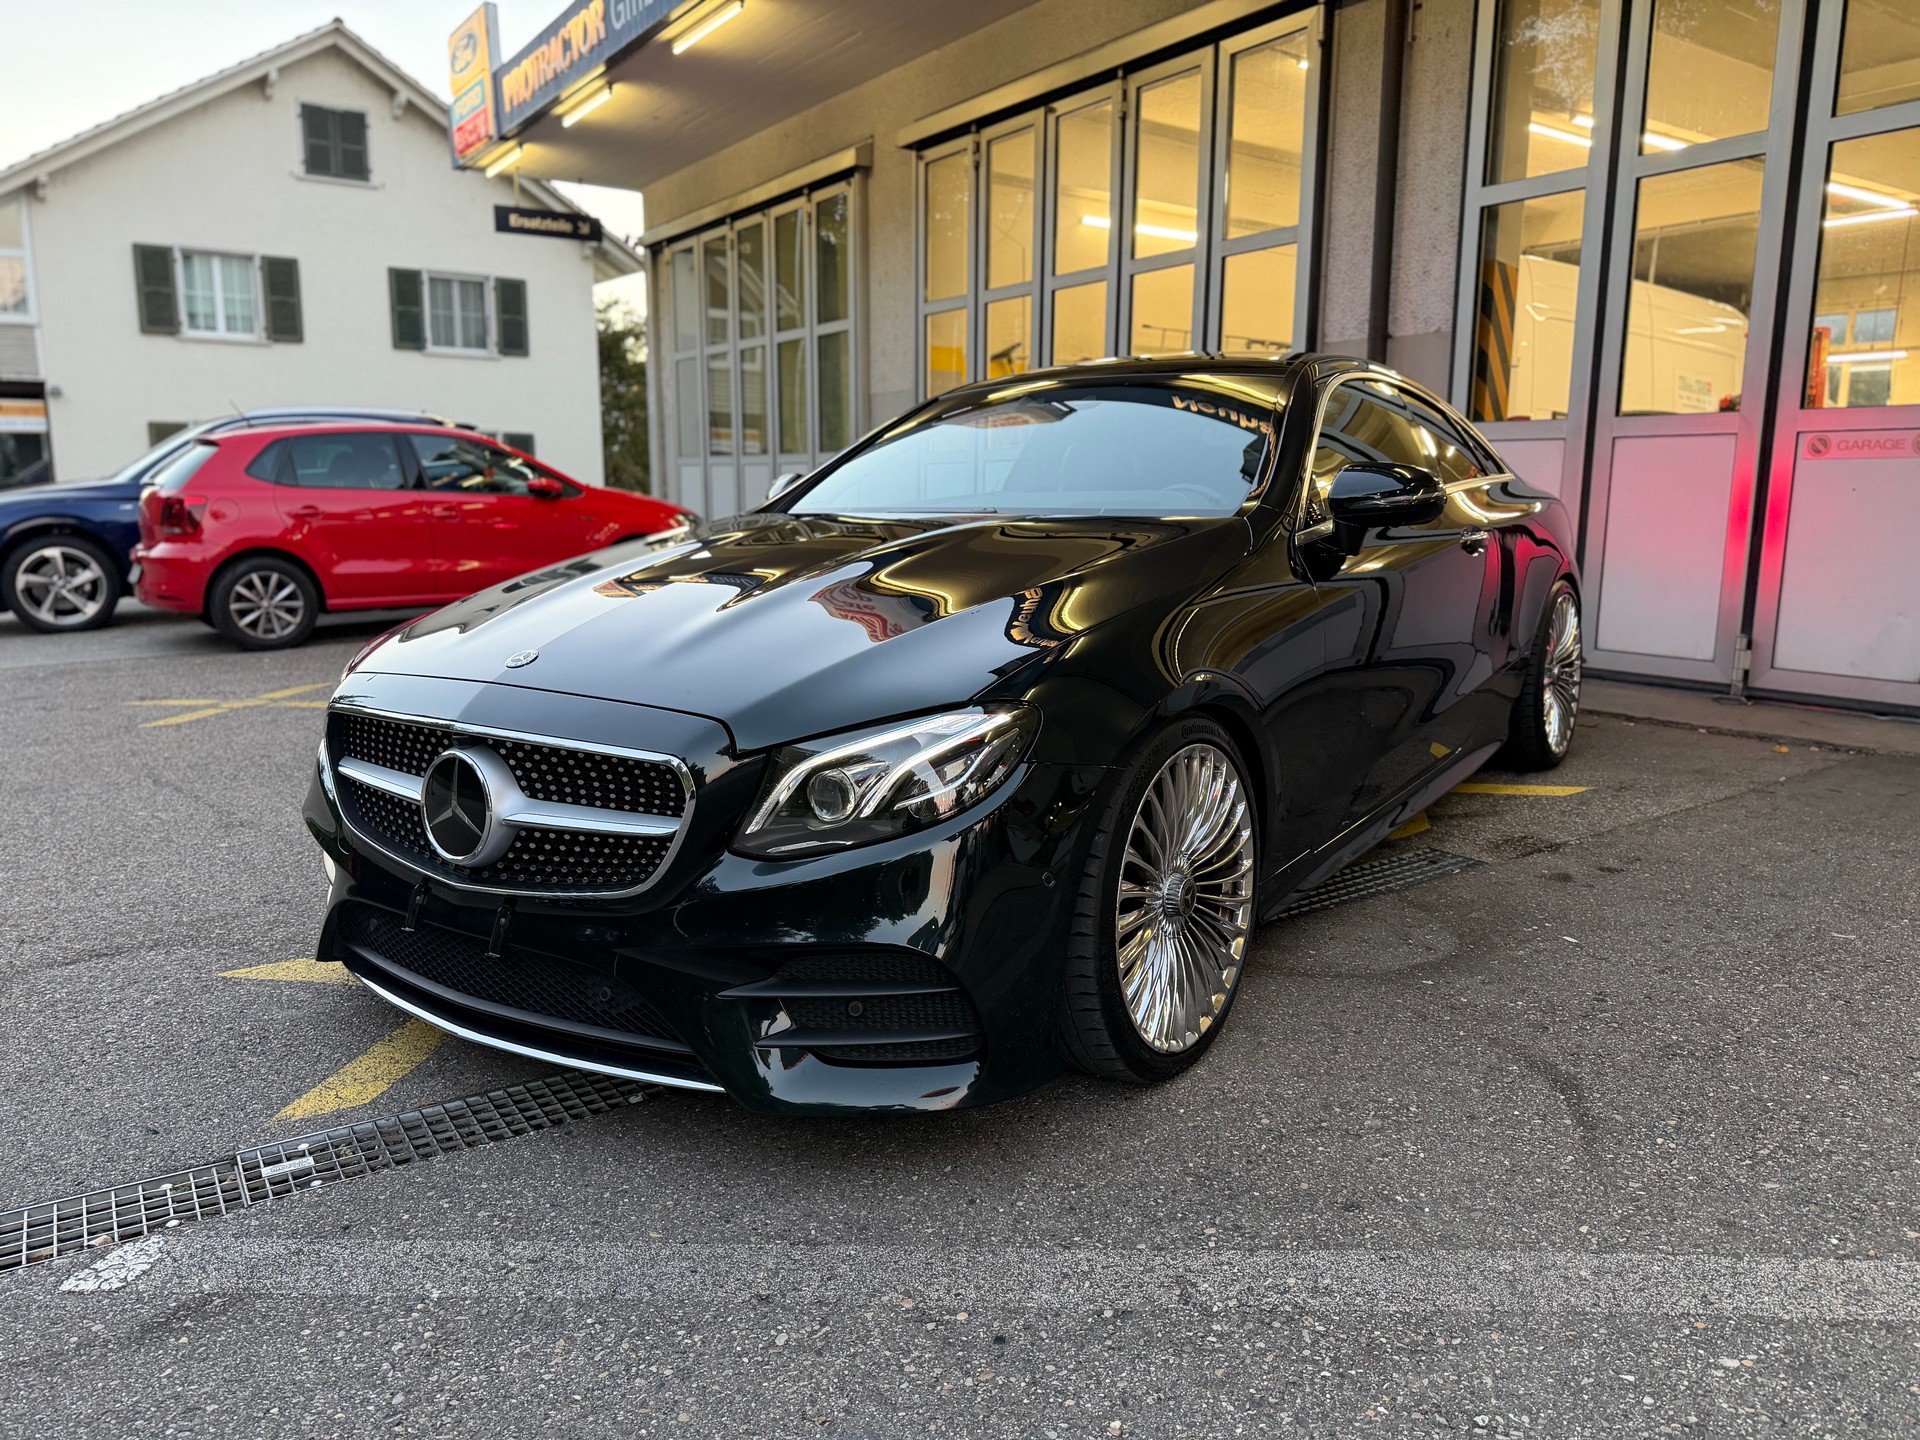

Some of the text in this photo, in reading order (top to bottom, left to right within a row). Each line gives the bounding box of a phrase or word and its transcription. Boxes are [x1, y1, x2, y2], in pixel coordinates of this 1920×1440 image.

[502, 0, 606, 113] PROTRACTOR
[1837, 438, 1906, 451] GARAGE
[1181, 722, 1217, 740] Continental
